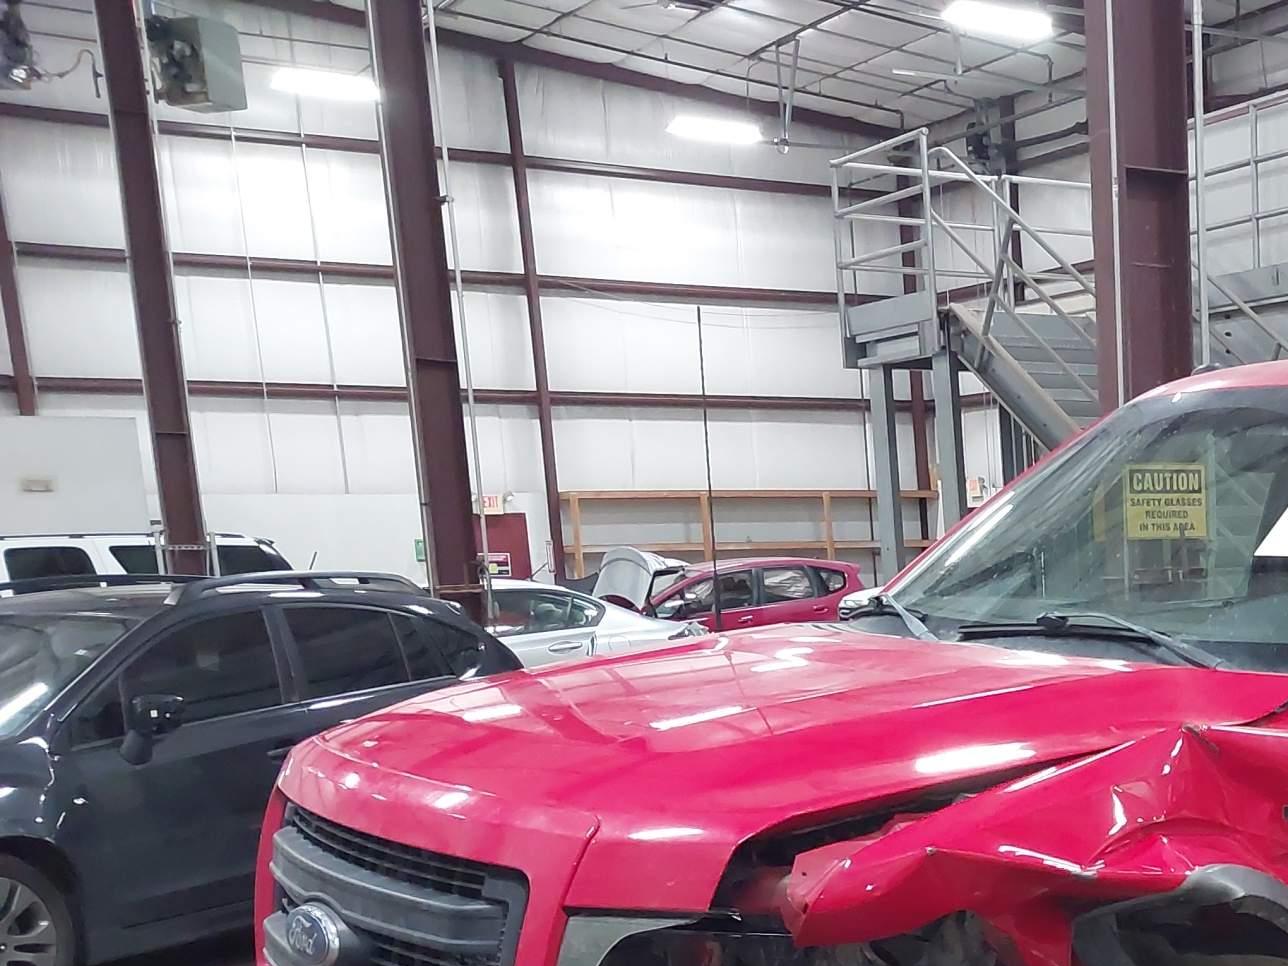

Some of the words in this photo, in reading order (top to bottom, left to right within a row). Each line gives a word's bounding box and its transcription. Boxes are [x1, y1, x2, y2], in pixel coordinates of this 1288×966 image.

[1132, 472, 1199, 491] CAUTION
[1130, 498, 1162, 507] SAFETY
[1164, 498, 1203, 507] GLASSES
[1145, 510, 1189, 519] REQUIRED
[1139, 522, 1149, 531] IN
[1151, 522, 1171, 531] THIS
[288, 914, 318, 956] Ford
